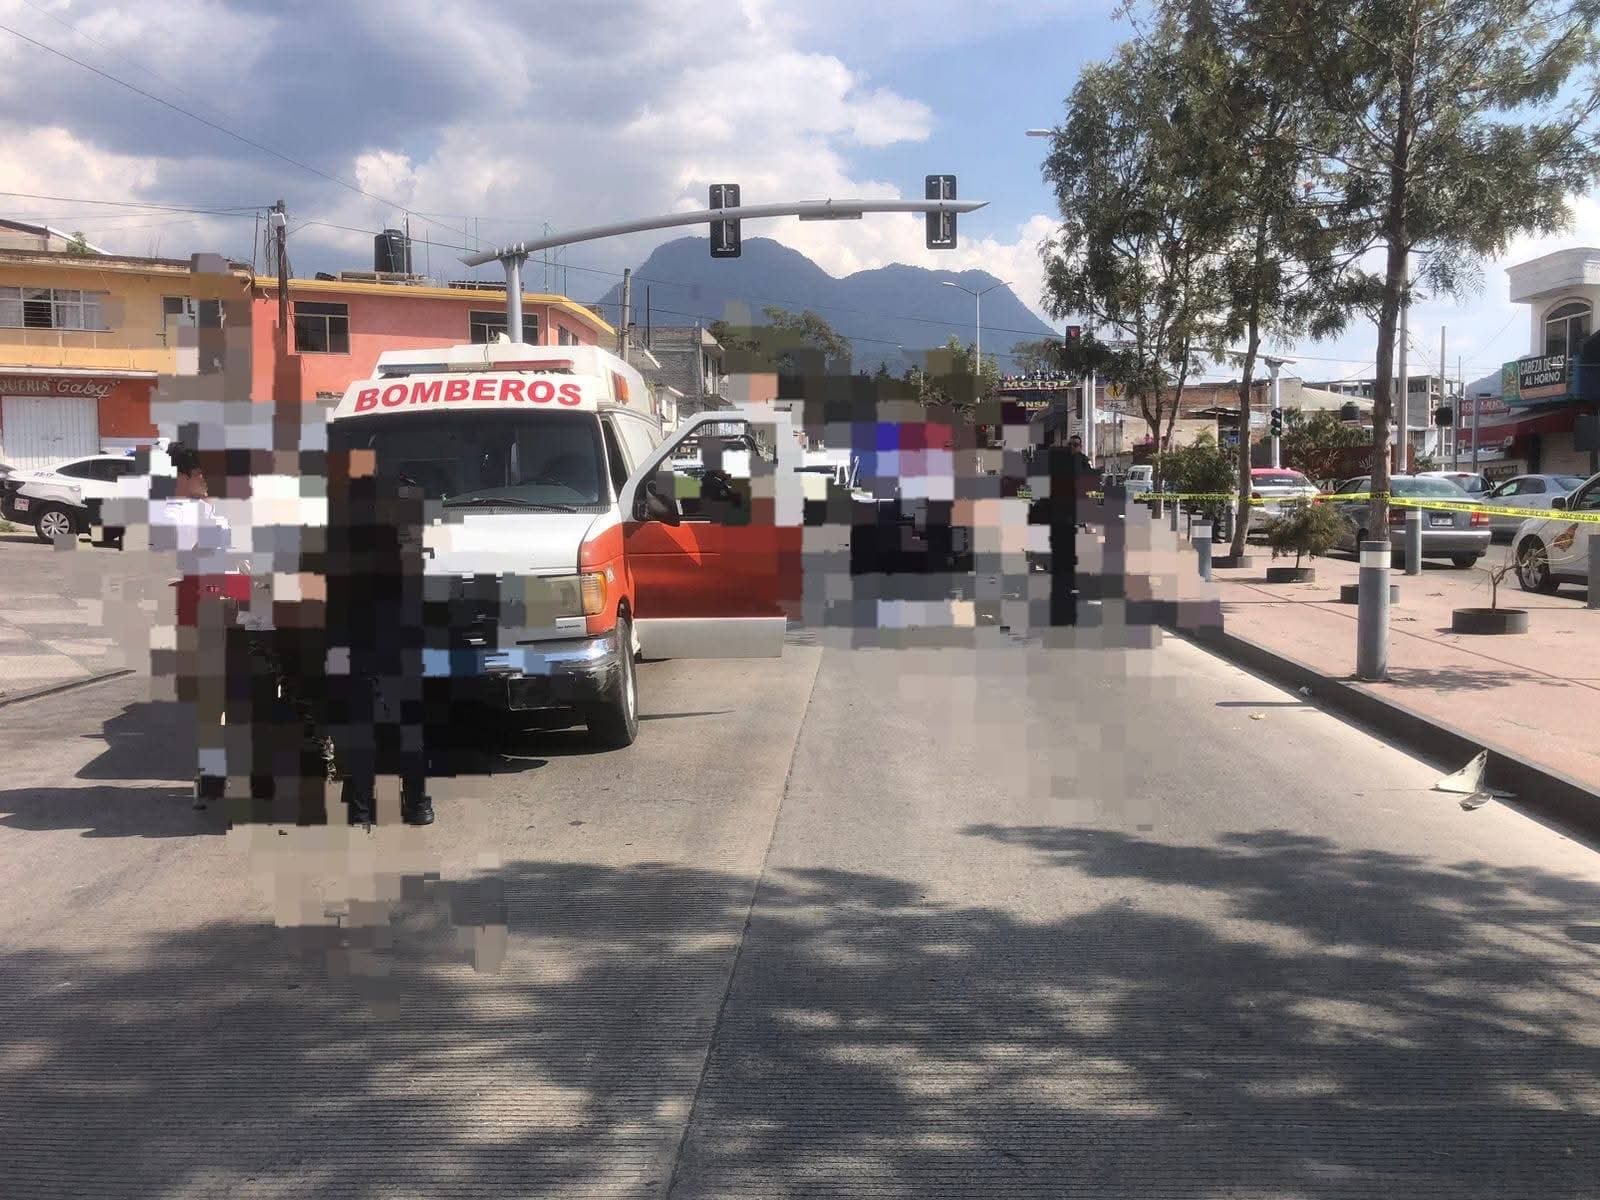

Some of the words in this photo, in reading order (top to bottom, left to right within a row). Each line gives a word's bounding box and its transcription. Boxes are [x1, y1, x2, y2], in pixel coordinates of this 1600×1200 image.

[1520, 359, 1542, 376] CABEZA
[1543, 357, 1551, 372] DE
[1524, 375, 1533, 386] AL
[1533, 371, 1561, 385] HORNO
[354, 378, 582, 412] BOMBEROS
